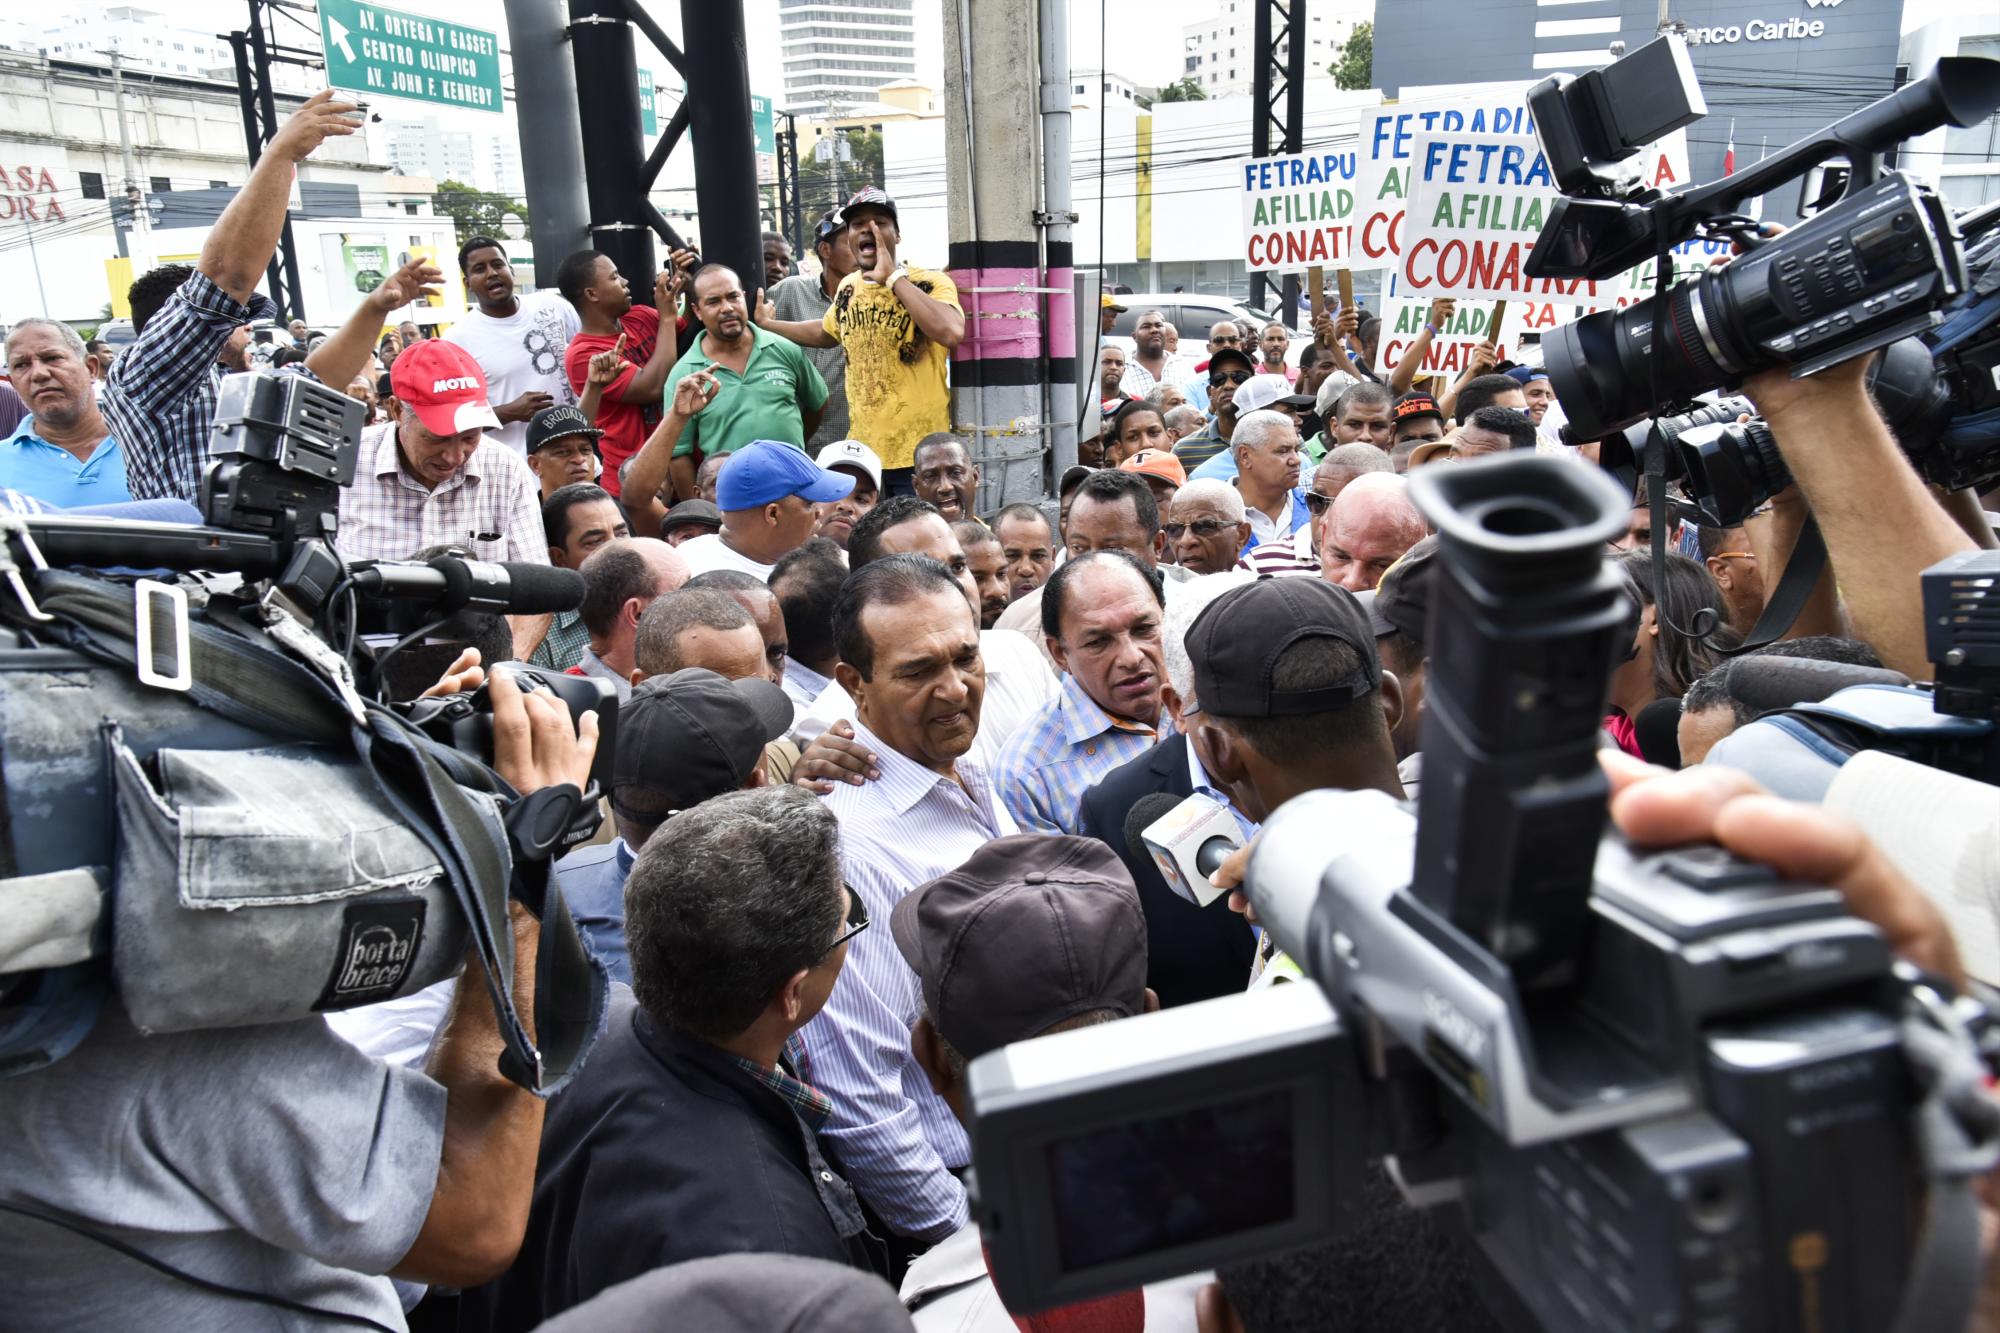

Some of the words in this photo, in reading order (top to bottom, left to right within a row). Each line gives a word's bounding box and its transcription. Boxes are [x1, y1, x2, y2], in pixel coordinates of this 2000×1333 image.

[359, 9, 379, 32] AV.
[384, 15, 434, 44] ORTEGA
[438, 27, 445, 46] Y
[450, 30, 493, 56] GASSET
[1684, 25, 1742, 45] nco
[1745, 17, 1825, 42] Caribe
[362, 38, 414, 66] CENTRO
[420, 49, 477, 78] OLIMPICO
[367, 67, 385, 88] AV.
[392, 71, 423, 94] JOHN
[428, 75, 437, 96] F.
[442, 80, 493, 106] KENNEDY
[1245, 153, 1356, 191] FETRAPU
[1424, 142, 1555, 187] FETRA
[1253, 189, 1354, 226] AFILIAD
[1432, 192, 1560, 233] AFILIA
[433, 376, 480, 393] MOTUL
[542, 407, 589, 430] BROOKLYN
[352, 938, 409, 967] porta
[341, 963, 402, 988] brace
